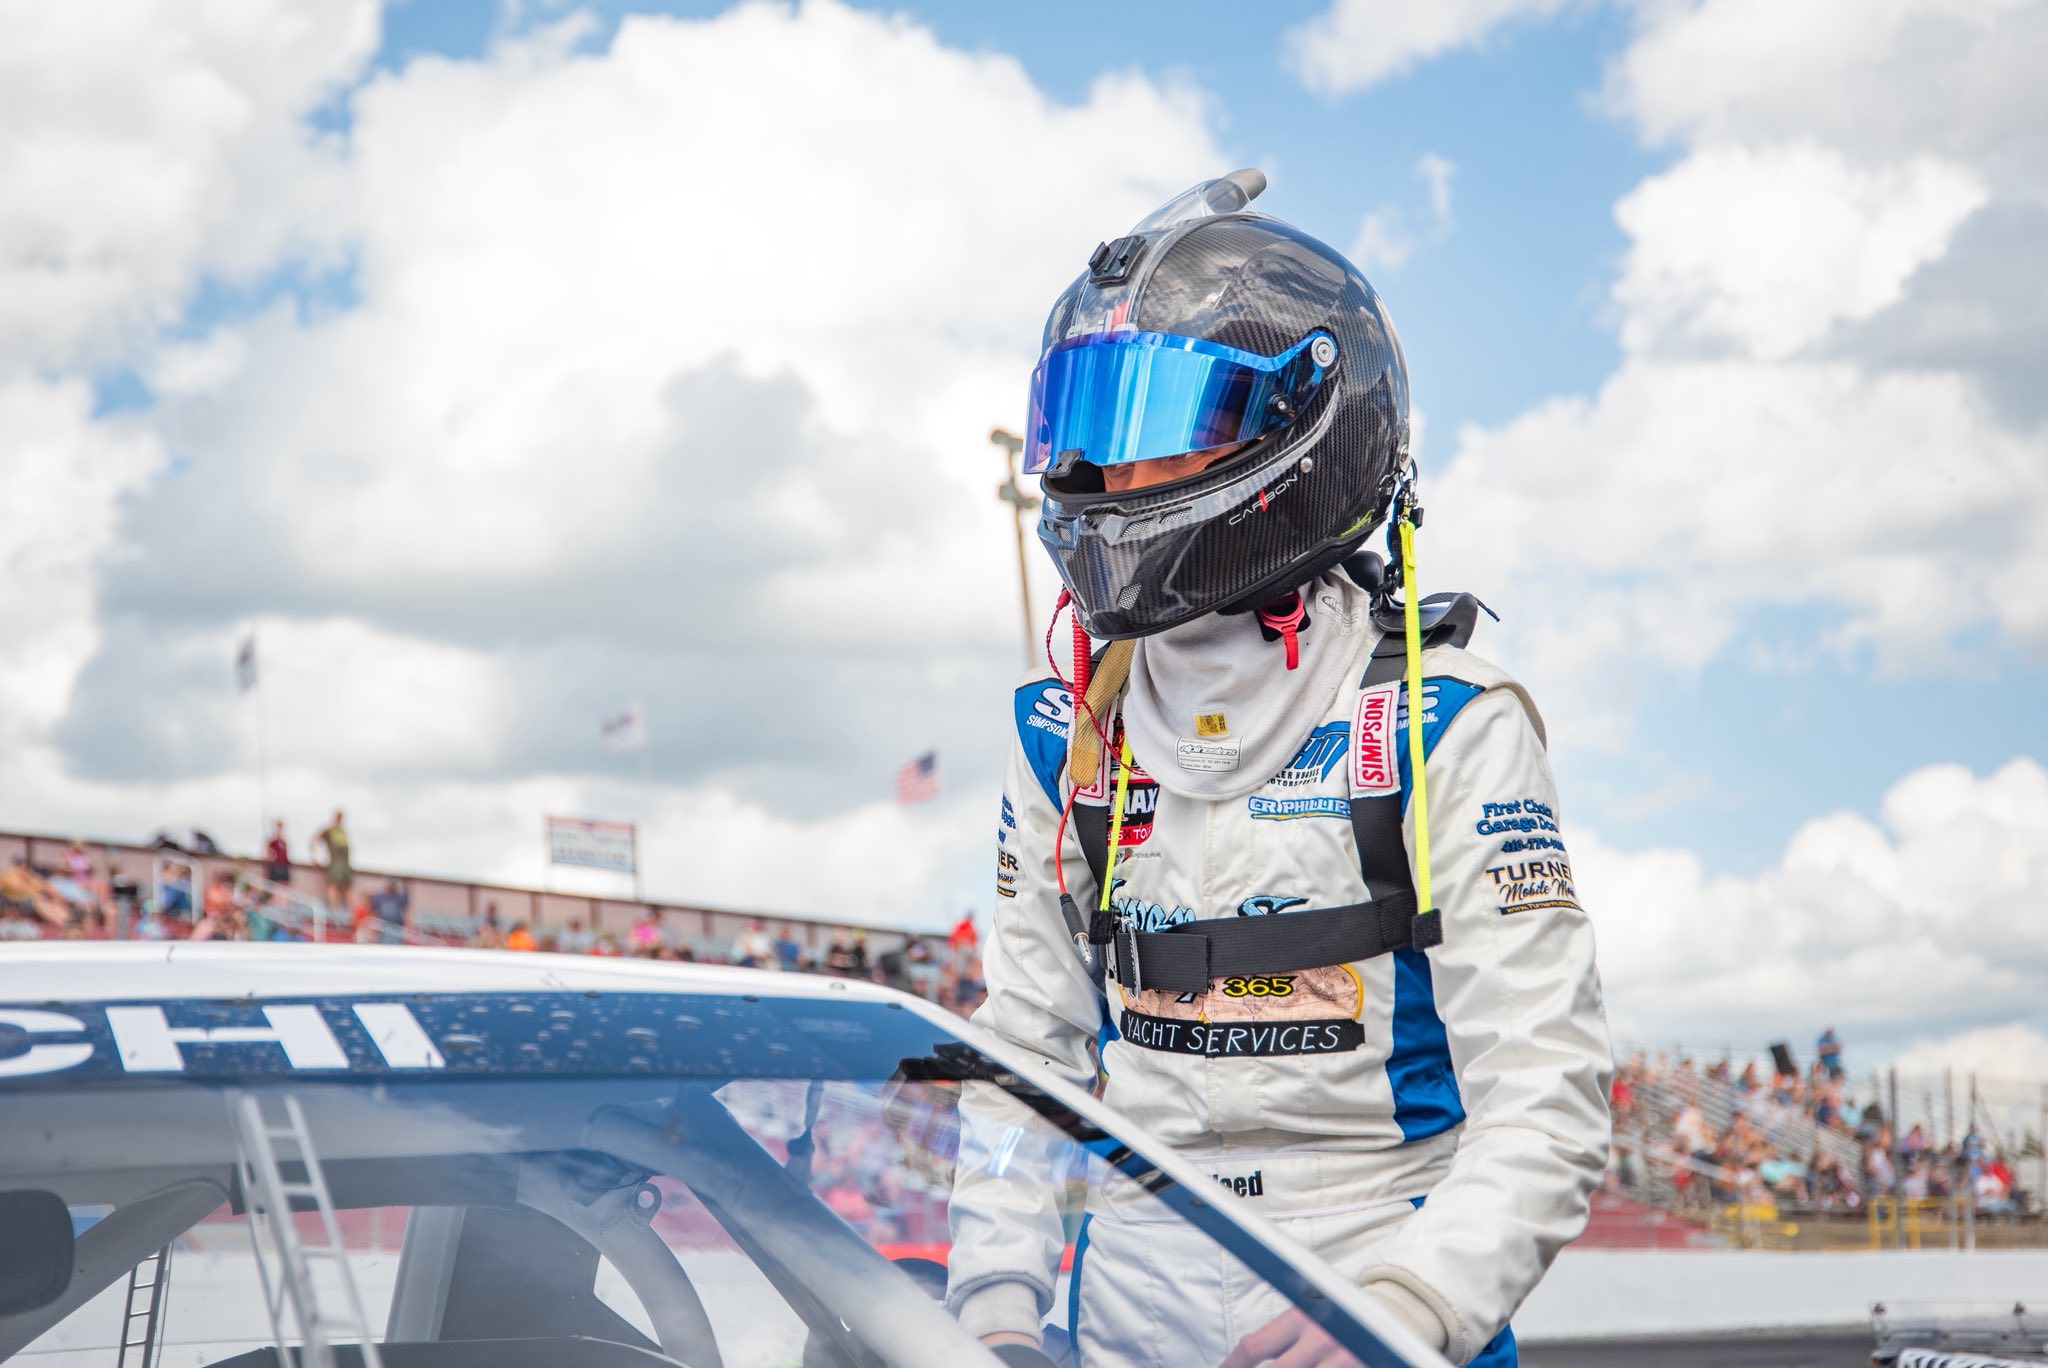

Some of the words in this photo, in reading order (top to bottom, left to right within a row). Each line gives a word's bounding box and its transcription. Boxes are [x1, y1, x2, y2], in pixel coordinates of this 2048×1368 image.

[1228, 473, 1298, 526] CARBON
[1361, 697, 1386, 783] SIMPSON
[1482, 800, 1522, 819] First
[1476, 817, 1538, 836] Garage
[1486, 861, 1572, 884] TURNE
[1499, 880, 1550, 904] Mobile
[1223, 976, 1298, 997] 365
[1126, 1014, 1181, 1048] YACHT
[1187, 1025, 1342, 1053] SERVICES
